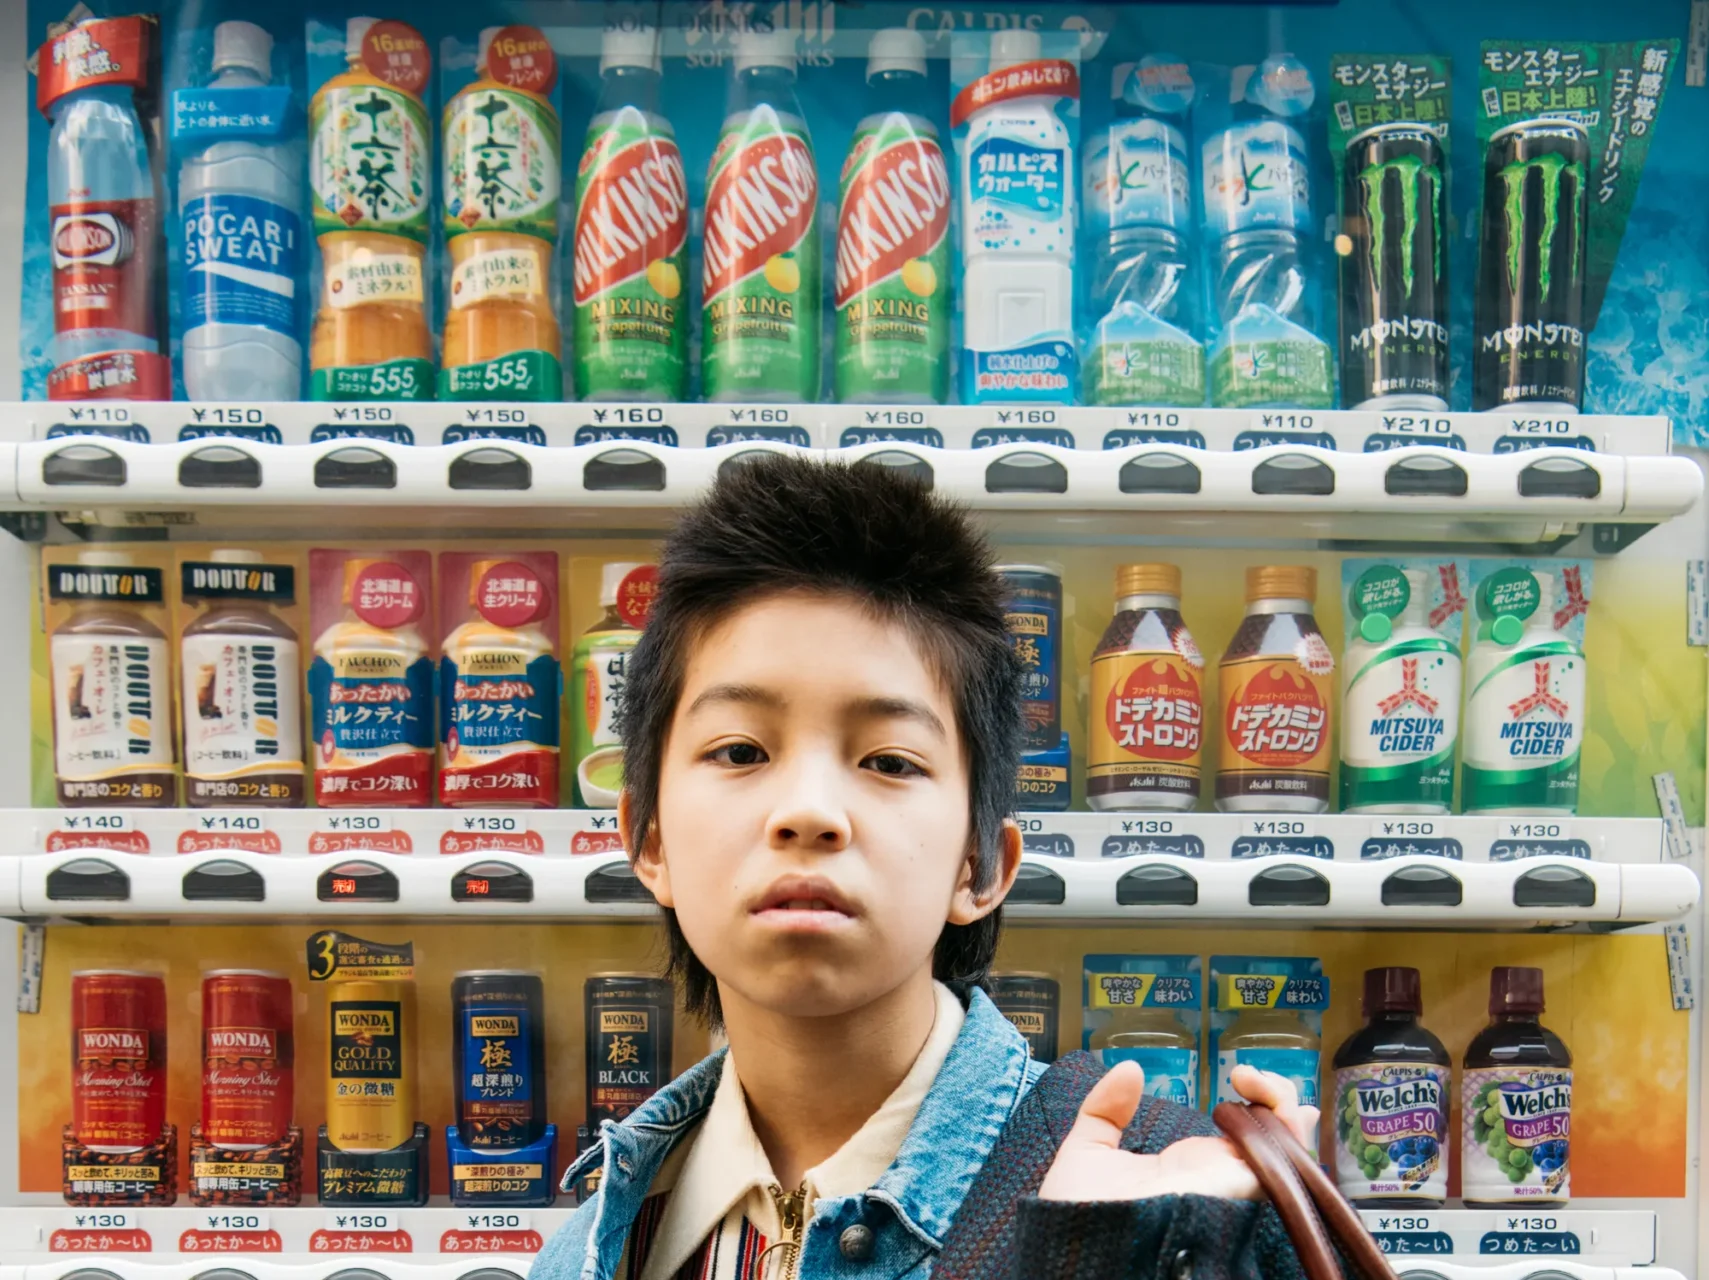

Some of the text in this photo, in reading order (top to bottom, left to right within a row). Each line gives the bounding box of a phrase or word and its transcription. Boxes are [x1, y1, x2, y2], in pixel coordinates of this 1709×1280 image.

[1484, 48, 1580, 72] モンスター
[1335, 60, 1428, 86] モンスター
[1525, 64, 1600, 87] エナジー
[1375, 77, 1446, 101] エナジー
[1630, 48, 1668, 137] 新感覚の
[1502, 86, 1597, 113] 日本上陸!
[349, 90, 406, 222] 十六茶
[471, 93, 522, 220] 十六茶
[978, 153, 1058, 174] カルピス
[977, 175, 1058, 193] ウォーター
[185, 213, 294, 249] POCARI
[185, 236, 284, 266] SWEAT
[591, 298, 674, 322] MIXING
[711, 298, 793, 320] MIXING
[848, 299, 929, 321] MIXING
[70, 408, 128, 421] ¥110
[193, 408, 262, 423] ¥150
[334, 407, 392, 421] ¥150
[466, 409, 526, 423] ¥150
[593, 407, 663, 423] ¥160
[729, 409, 789, 423] ¥160
[865, 411, 924, 425] ¥160
[998, 410, 1056, 423] ¥160
[1128, 413, 1179, 426] ¥110
[1262, 415, 1314, 429] ¥110
[1383, 416, 1452, 433] ¥210
[1512, 419, 1570, 433] ¥210
[60, 571, 149, 595] DOUTOR
[193, 568, 276, 592] DOUTOR
[1362, 578, 1400, 593] ココロが
[1494, 580, 1531, 595] ココロが
[330, 684, 411, 702] あったかい
[454, 681, 534, 699] あったかい
[124, 645, 153, 755] DOUTOR
[251, 645, 279, 756] DOUTOR
[325, 706, 418, 725] ミルクティー
[450, 703, 543, 722] ミルクティー
[1115, 697, 1202, 724] ドデカミン
[1232, 703, 1325, 731] ドデカミン
[1369, 717, 1444, 736] MITSUYA
[1500, 721, 1573, 739] MITSUYA
[1118, 724, 1199, 751] ストロング
[1237, 729, 1320, 753] ストロング
[1378, 735, 1436, 752] CIDER
[1509, 739, 1565, 756] CIDER
[195, 782, 290, 797] 専門店のコクと香り
[321, 775, 418, 793] 濃厚でコク深い
[444, 773, 540, 791] 濃厚でコク深い
[1129, 776, 1192, 790] Asahi 炭酸飲料
[1249, 780, 1308, 791] Asahi 炭酸飲料
[64, 816, 123, 829] ¥140
[201, 817, 260, 830] ¥140
[328, 817, 380, 829] ¥130
[464, 817, 516, 830] ¥130
[1121, 821, 1173, 833] ¥130
[1254, 822, 1304, 834] ¥130
[1383, 823, 1433, 835] ¥130
[1510, 824, 1560, 837] ¥130
[466, 880, 489, 894] 売切
[311, 935, 335, 978] 3
[1156, 978, 1191, 989] クリアな
[1288, 979, 1320, 990] クリアな
[1109, 989, 1135, 1005] 甘さ
[1154, 989, 1194, 1004] 味わい
[1242, 989, 1269, 1006] 甘さ
[1286, 991, 1324, 1005] 味わい
[339, 1014, 391, 1027] WONDA
[475, 1019, 516, 1030] WONDA
[604, 1014, 644, 1026] WONDA
[83, 1033, 144, 1049] WONDA
[211, 1032, 271, 1048] WONDA
[338, 1047, 391, 1060] GOLD
[479, 1039, 513, 1069] 極
[607, 1034, 640, 1065] 極
[334, 1060, 396, 1072] QUALITY
[1382, 1068, 1414, 1078] CALPIS
[471, 1073, 524, 1088] 超深煎り
[598, 1070, 650, 1085] BLACK
[1529, 1072, 1556, 1082] CALPIS
[336, 1082, 395, 1097] 金の微糖
[480, 1088, 515, 1098] ブレンド
[1357, 1082, 1438, 1113] Welch's
[1366, 1112, 1435, 1133] GRAPE 50
[1512, 1116, 1569, 1138] GRAPE 50
[493, 1135, 523, 1145] コーヒー
[463, 1179, 530, 1193] 超深煎りのコク
[76, 1215, 127, 1227] ¥130
[208, 1216, 260, 1228] ¥130
[336, 1216, 388, 1228] ¥130
[469, 1216, 520, 1228] ¥130
[1379, 1218, 1429, 1230] ¥130
[1507, 1218, 1557, 1230] ¥130
[1377, 1238, 1449, 1253] めた～い
